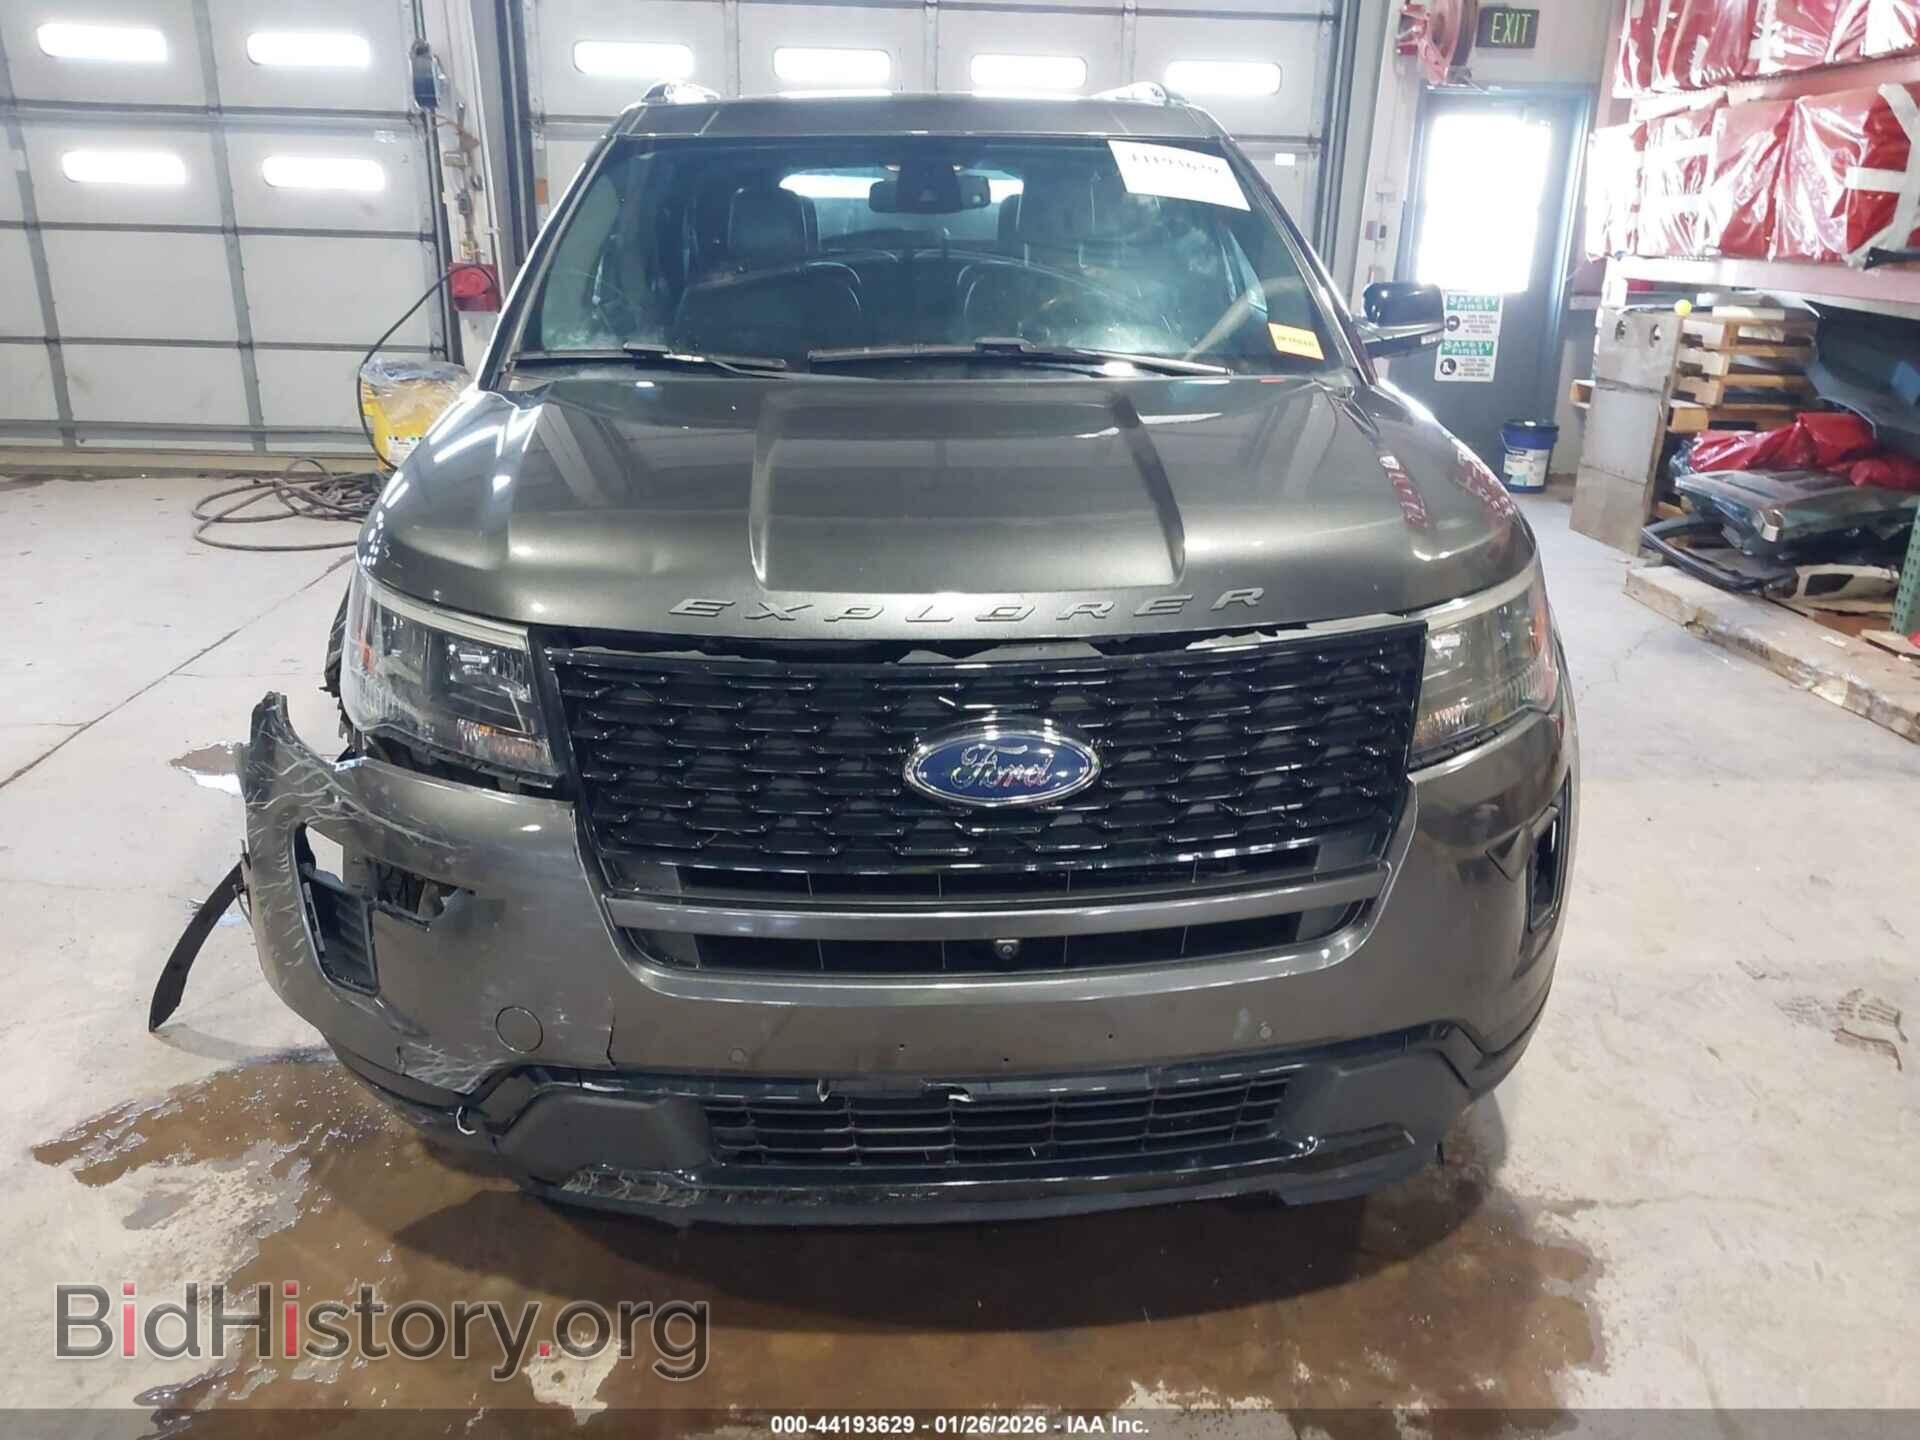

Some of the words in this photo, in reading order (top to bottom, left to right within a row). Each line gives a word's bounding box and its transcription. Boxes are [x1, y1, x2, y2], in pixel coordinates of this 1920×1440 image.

[1491, 12, 1532, 44] EXIT
[1448, 295, 1498, 305] SAFETY
[1444, 341, 1492, 350] SAFETY
[1452, 348, 1485, 356] FIRST
[667, 586, 1266, 623] EXPLORER
[951, 744, 1055, 789] Ford
